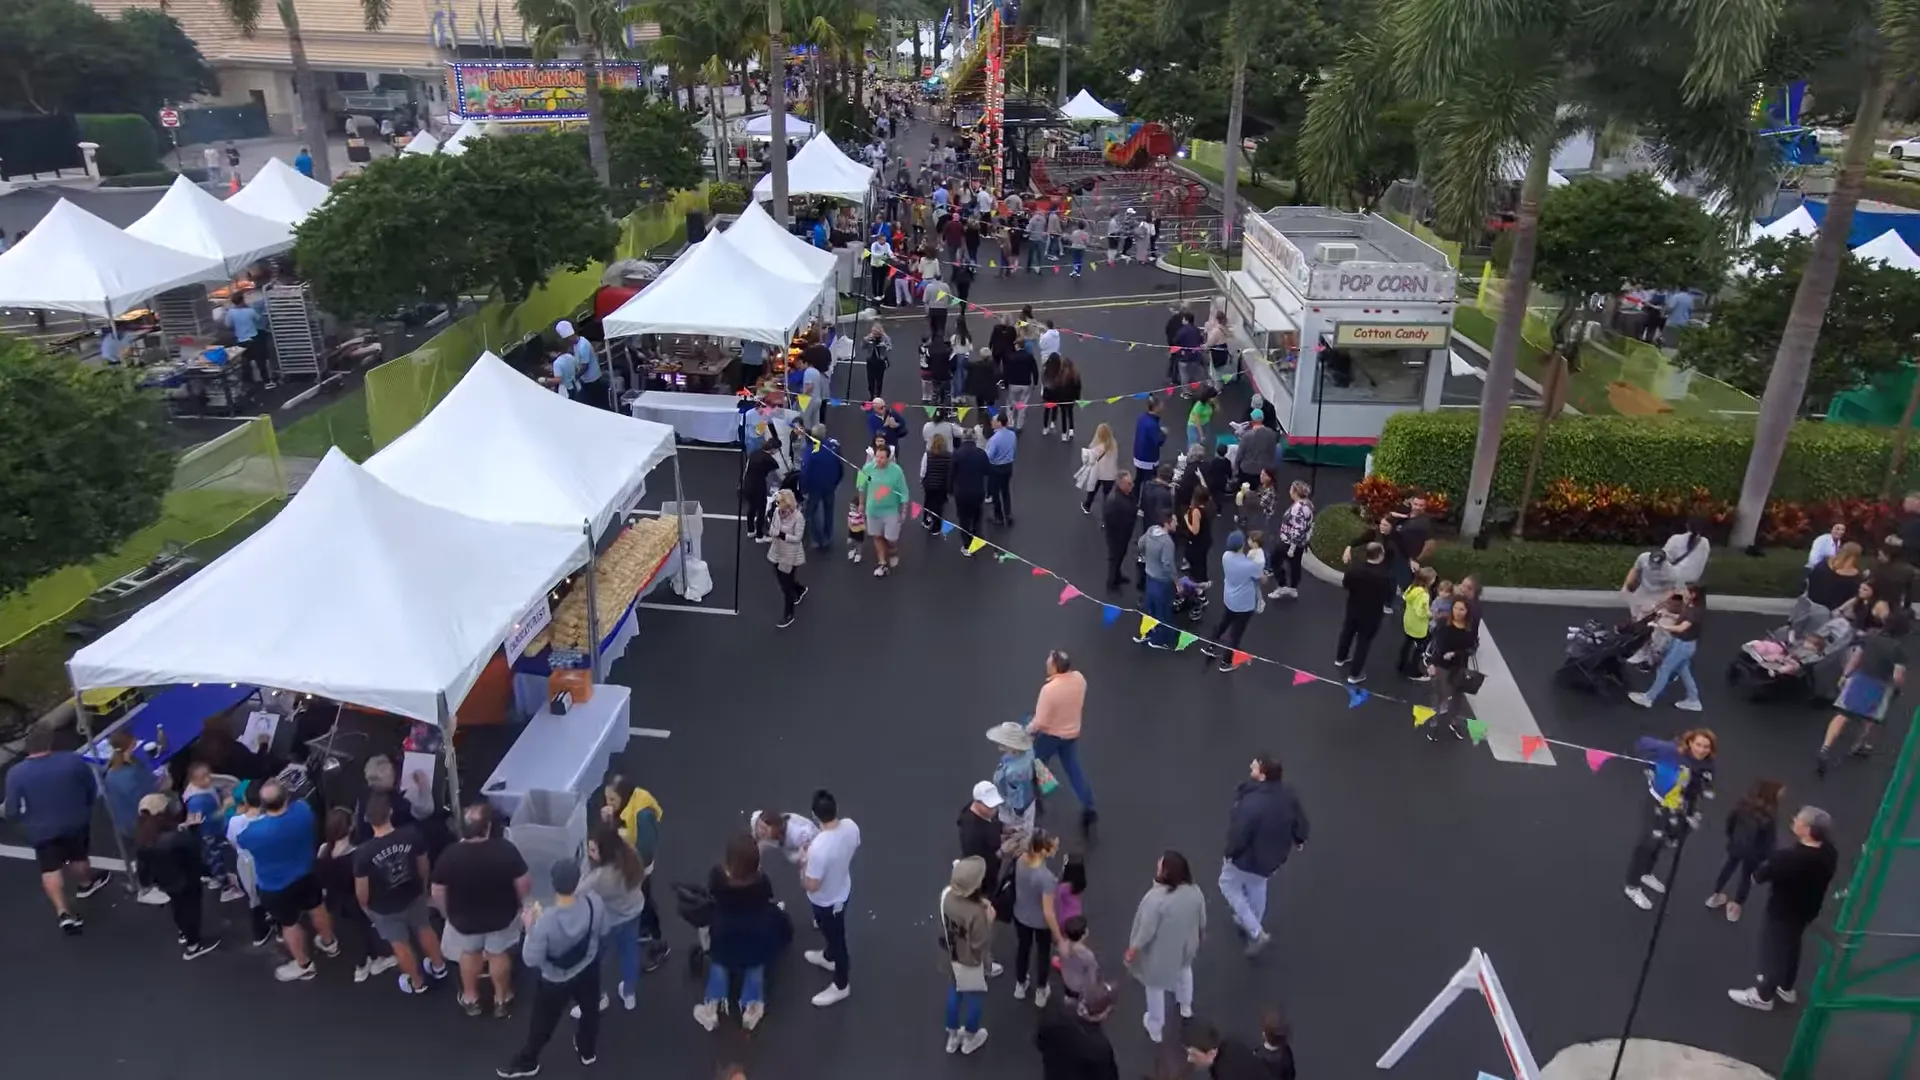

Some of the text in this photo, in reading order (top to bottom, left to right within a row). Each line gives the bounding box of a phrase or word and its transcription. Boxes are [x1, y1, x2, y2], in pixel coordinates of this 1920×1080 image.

[488, 69, 534, 91] FUNNEL
[1339, 274, 1429, 293] POP CORN
[1353, 327, 1429, 341] Cotton Candy
[371, 843, 413, 867] FREEDOM
